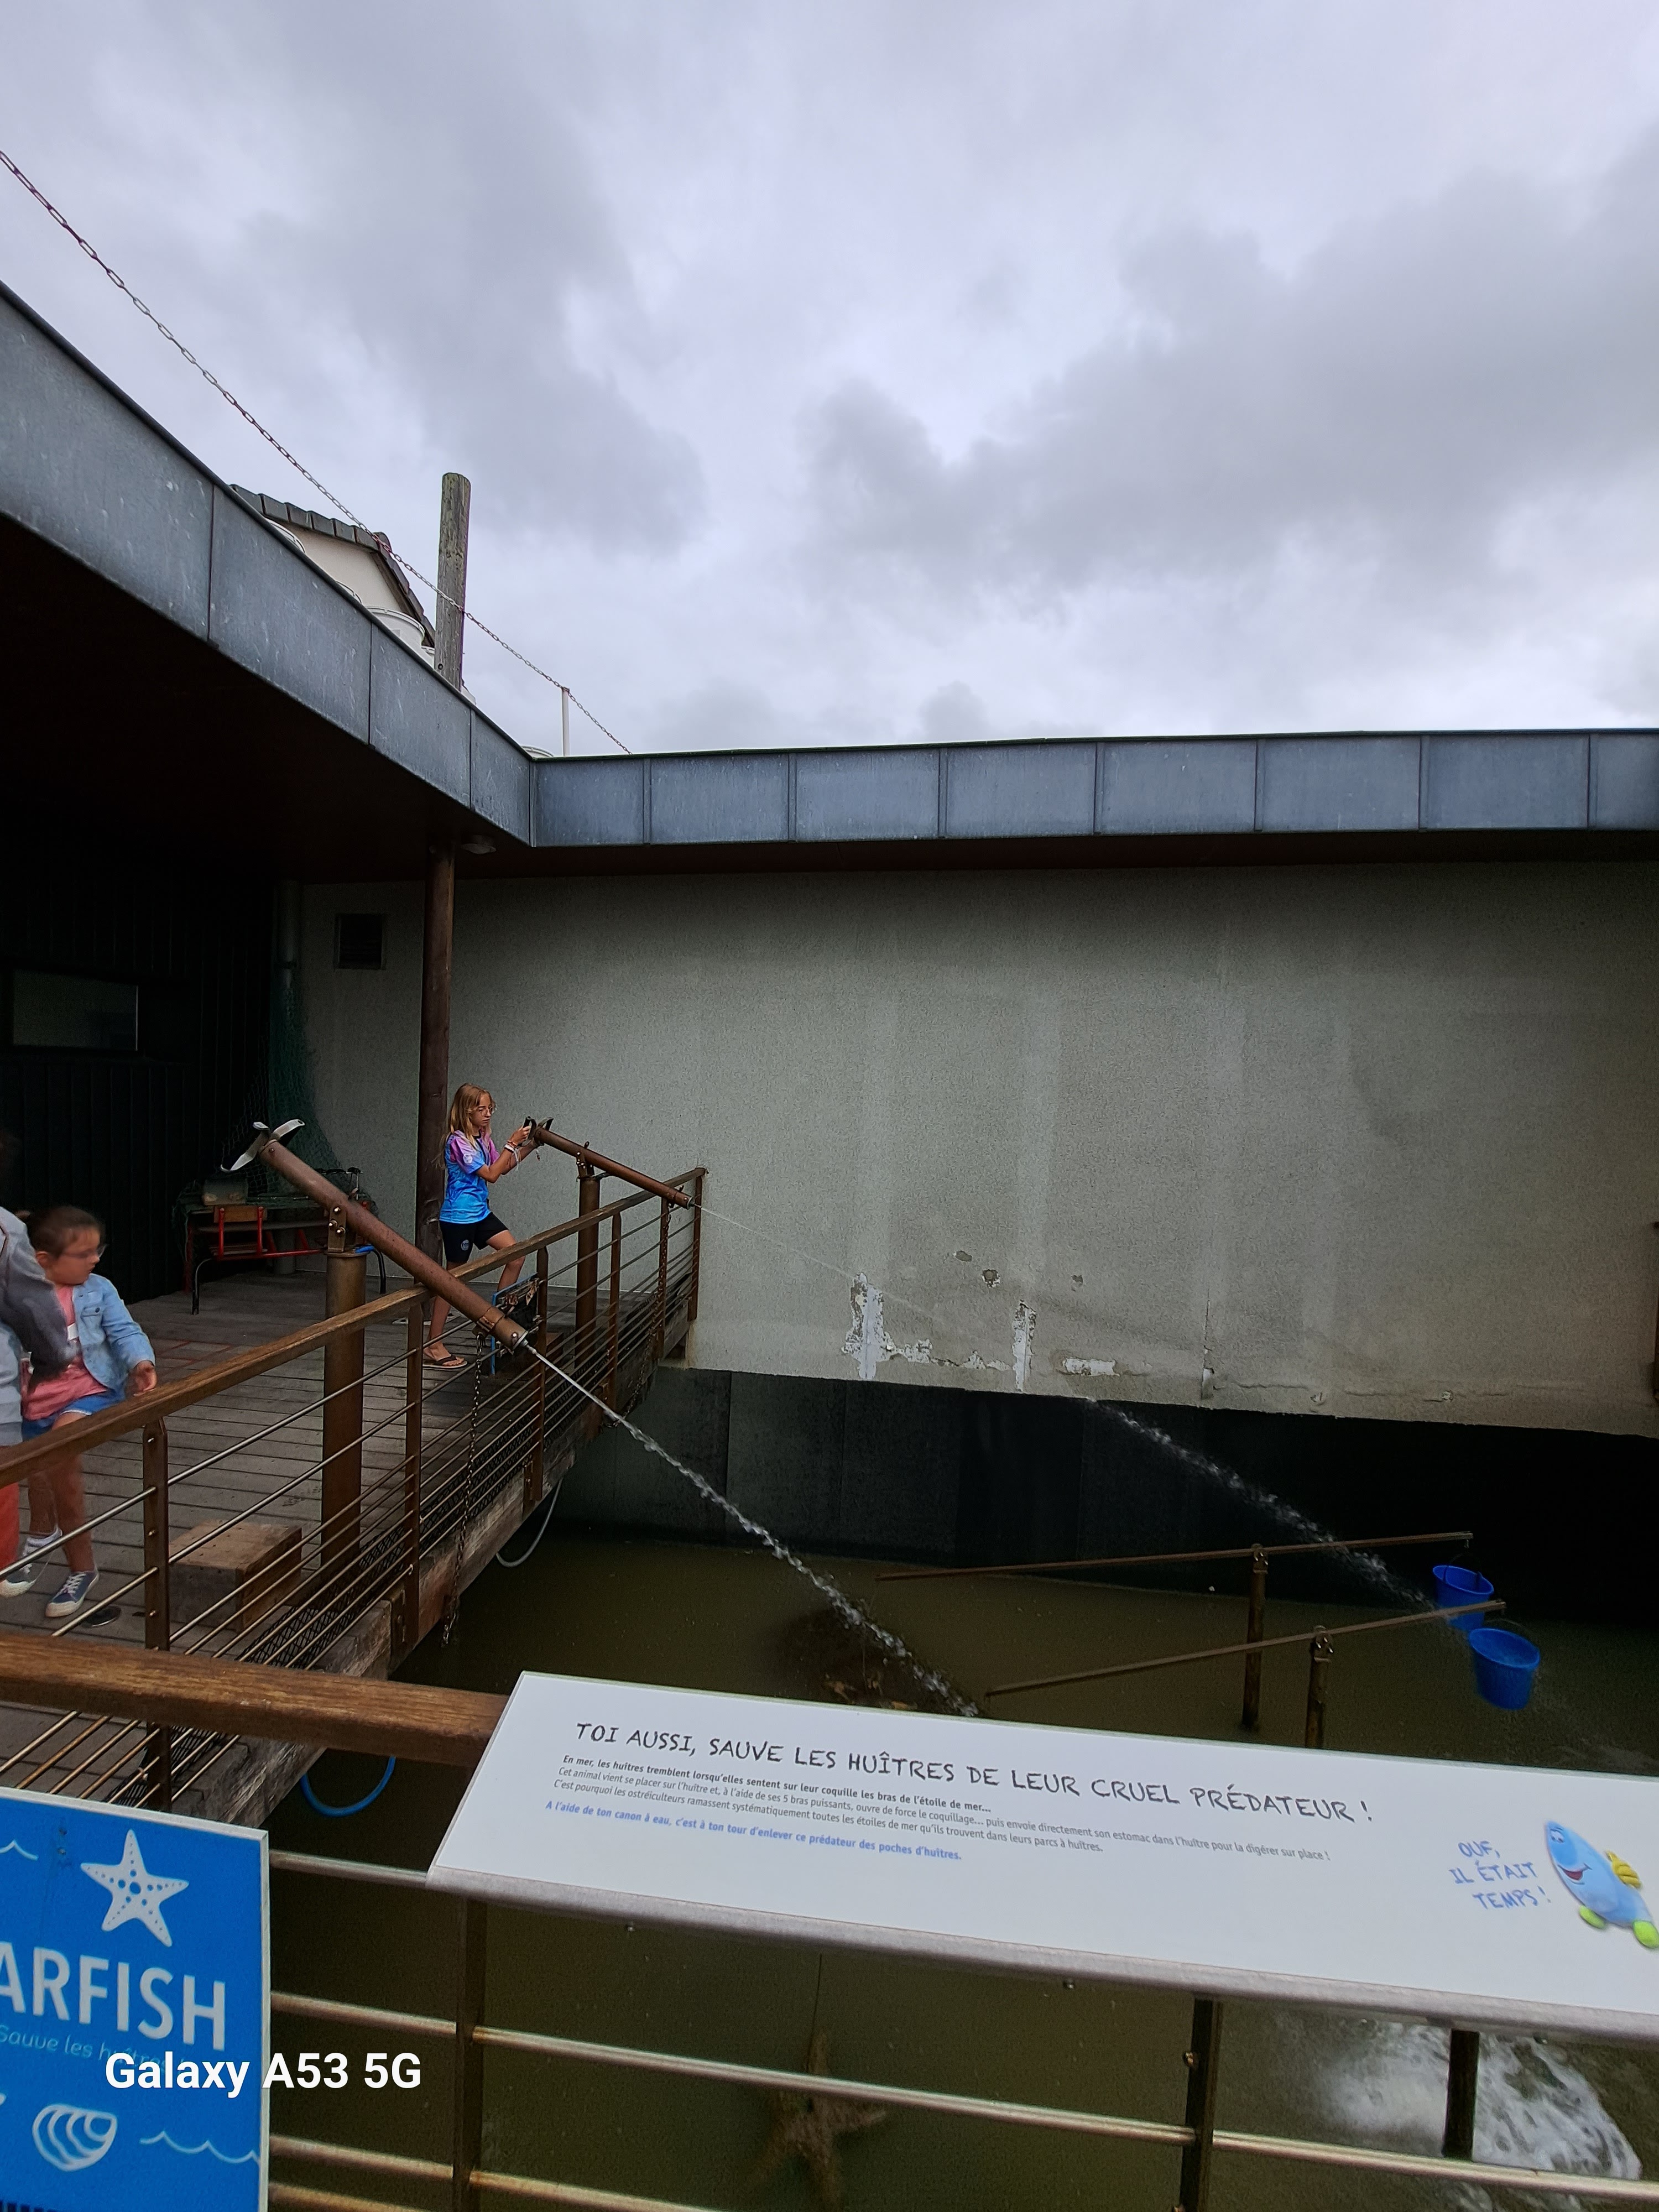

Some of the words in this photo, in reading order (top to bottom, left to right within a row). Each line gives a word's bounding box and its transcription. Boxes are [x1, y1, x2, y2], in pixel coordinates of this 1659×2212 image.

[563, 1755, 573, 1764] En
[576, 1758, 594, 1767] mer,
[597, 1759, 610, 1768] les
[613, 1761, 643, 1773] huîtres
[646, 1765, 689, 1778] tremblent
[693, 1770, 743, 1785] lorsqu'elles
[747, 1778, 780, 1790] sentent
[800, 1783, 818, 1793] leur
[821, 1787, 857, 1798] coquille
[861, 1790, 874, 1800] les
[878, 1791, 896, 1802] bras
[900, 1794, 910, 1804] de
[914, 1795, 946, 1808] l'étoile
[950, 1799, 961, 1809] de
[576, 1723, 619, 1743] TOI
[626, 1729, 695, 1757] AUSSI,
[709, 1738, 784, 1762] SAUVE
[795, 1746, 836, 1769] LES
[848, 1751, 954, 1782] HUÎTRES
[966, 1766, 999, 1786] DE
[1011, 1770, 1079, 1797] LEUR
[1091, 1779, 1181, 1804] CRUEL
[1190, 1784, 1354, 1823] PRÉDATEUR
[554, 1778, 573, 1790] C'est
[575, 1783, 613, 1795] pourquoi
[614, 1786, 625, 1797] les
[628, 1790, 685, 1804] ostréiculteurs
[687, 1797, 729, 1810] ramassent
[732, 1803, 810, 1819] systématiquement
[812, 1811, 839, 1823] toutes
[842, 1813, 854, 1824] les
[857, 1816, 885, 1828] étoiles
[888, 1819, 898, 1829] de
[901, 1823, 917, 1831] mer
[920, 1824, 943, 1835] qu'ils
[946, 1826, 984, 1839] trouvent
[987, 1830, 1006, 1842] dans
[1010, 1832, 1031, 1844] leurs
[1034, 1838, 1058, 1848] parcs
[1060, 1838, 1065, 1848] à
[1068, 1839, 1103, 1852] huîtres.
[555, 1801, 580, 1813] l'aide
[582, 1805, 593, 1815] de
[597, 1807, 611, 1817] ton
[614, 1811, 641, 1821] canon
[645, 1813, 650, 1823] à
[653, 1816, 671, 1826] eau,
[675, 1818, 696, 1829] c'est
[700, 1820, 705, 1830] à
[709, 1822, 723, 1832] ton
[727, 1824, 747, 1834] tour
[750, 1827, 792, 1840] d'enlever
[796, 1834, 805, 1842] ce
[809, 1834, 855, 1848] prédateur
[859, 1839, 875, 1850] des
[879, 1843, 912, 1855] poches
[559, 1766, 571, 1777] Cet
[573, 1769, 600, 1780] animal
[602, 1772, 623, 1783] vient
[635, 1776, 661, 1787] placer
[663, 1781, 676, 1790] sur
[709, 1787, 721, 1796] et,
[723, 1787, 728, 1796] à
[731, 1787, 753, 1799] l'aide
[755, 1791, 765, 1801] de
[768, 1794, 780, 1802] ses
[783, 1794, 787, 1803] 5
[791, 1794, 807, 1806] bras
[811, 1798, 853, 1812] puissants,
[856, 1804, 879, 1814] ouvre
[882, 1805, 892, 1815] de
[895, 1806, 916, 1818] force
[919, 1809, 926, 1819] le
[986, 1817, 1004, 1828] puis
[1006, 1820, 1035, 1832] envoie
[1039, 1822, 1091, 1837] directement
[1094, 1830, 1110, 1839] son
[1113, 1832, 1150, 1843] estomac
[1152, 1834, 1173, 1845] dans
[1212, 1841, 1232, 1851] pour
[1234, 1841, 1243, 1853] la
[1245, 1843, 1279, 1856] digérer
[1281, 1849, 1295, 1858] sur
[1297, 1848, 1322, 1860] place
[1449, 1867, 1474, 1884] IL
[1474, 1859, 1538, 1881] ÉTAIT
[1458, 1840, 1500, 1858] OUF,
[1472, 1888, 1538, 1910] TEMPS
[64, 2034, 93, 2058] les
